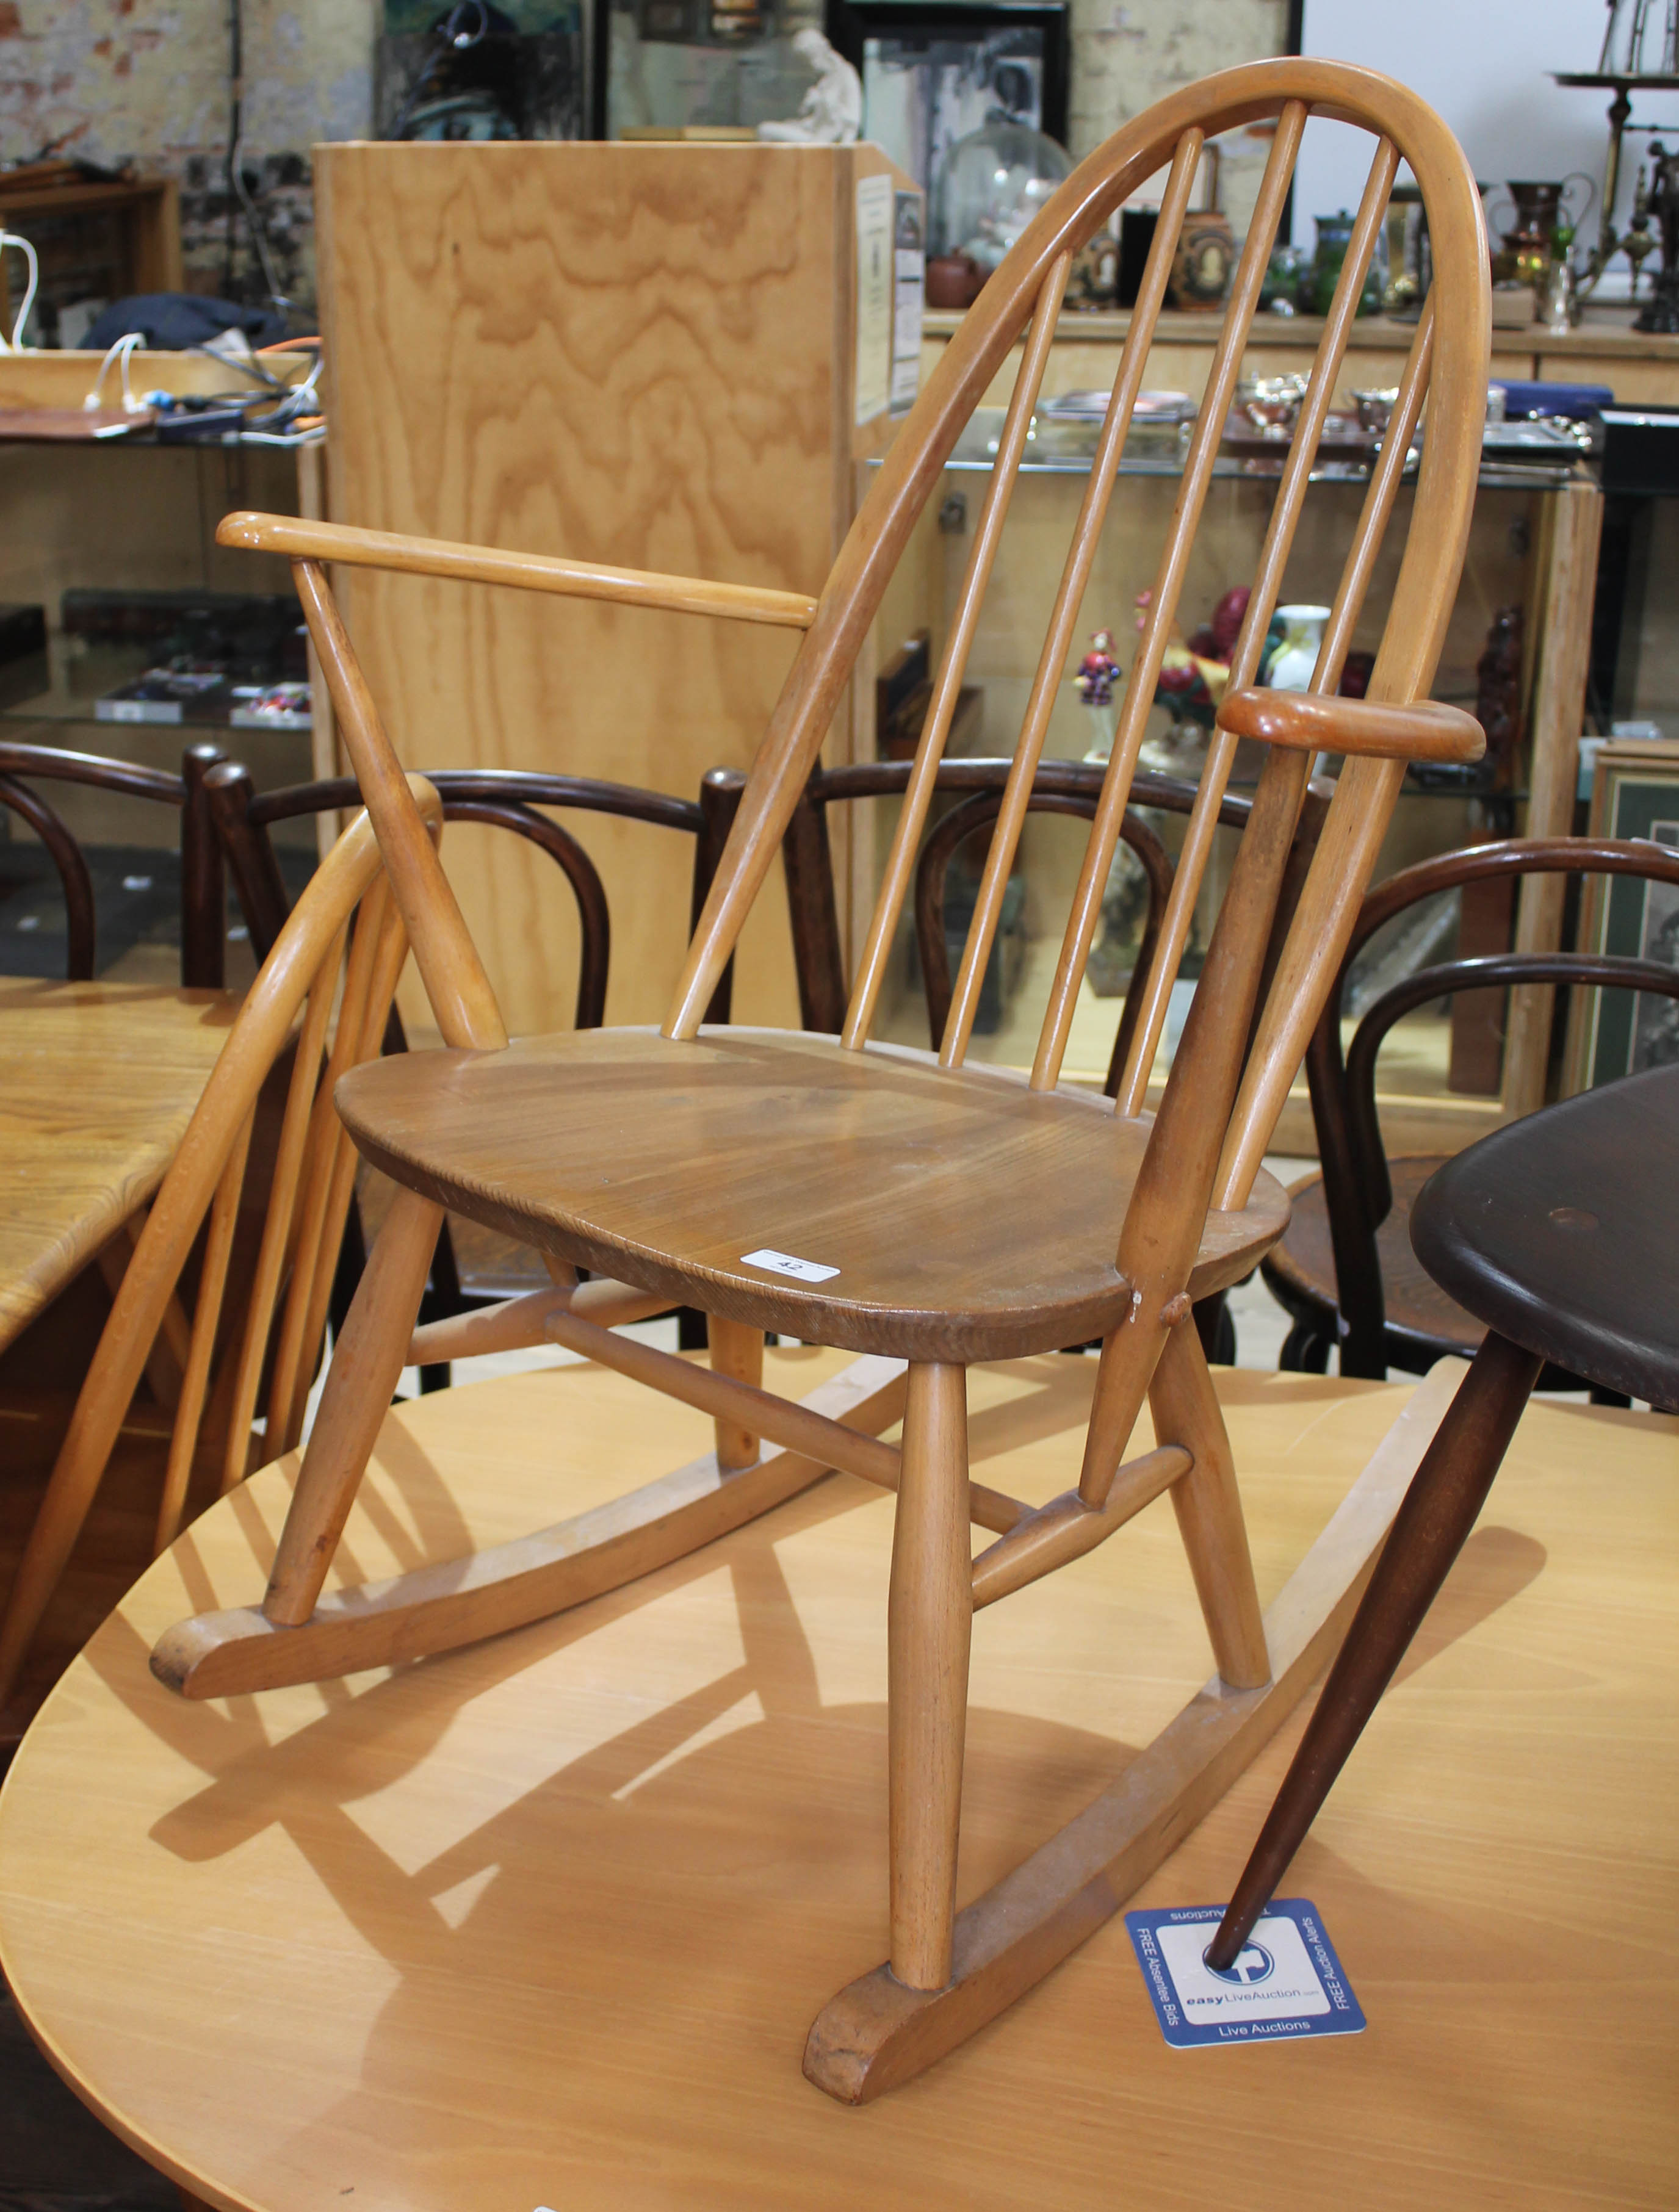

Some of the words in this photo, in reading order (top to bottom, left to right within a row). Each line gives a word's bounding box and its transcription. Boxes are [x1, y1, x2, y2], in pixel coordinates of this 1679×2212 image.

[777, 1262, 803, 1271] 42
[1302, 1916, 1321, 1944] Alerts
[1137, 1928, 1157, 1956] FREE
[1147, 1957, 1170, 2002] Absentee
[1163, 2004, 1180, 2026] Bids
[1315, 1945, 1337, 1980] Auction
[1327, 1980, 1350, 2010] FREE
[1219, 2026, 1248, 2036] Live
[1252, 2020, 1311, 2034] Auctions
